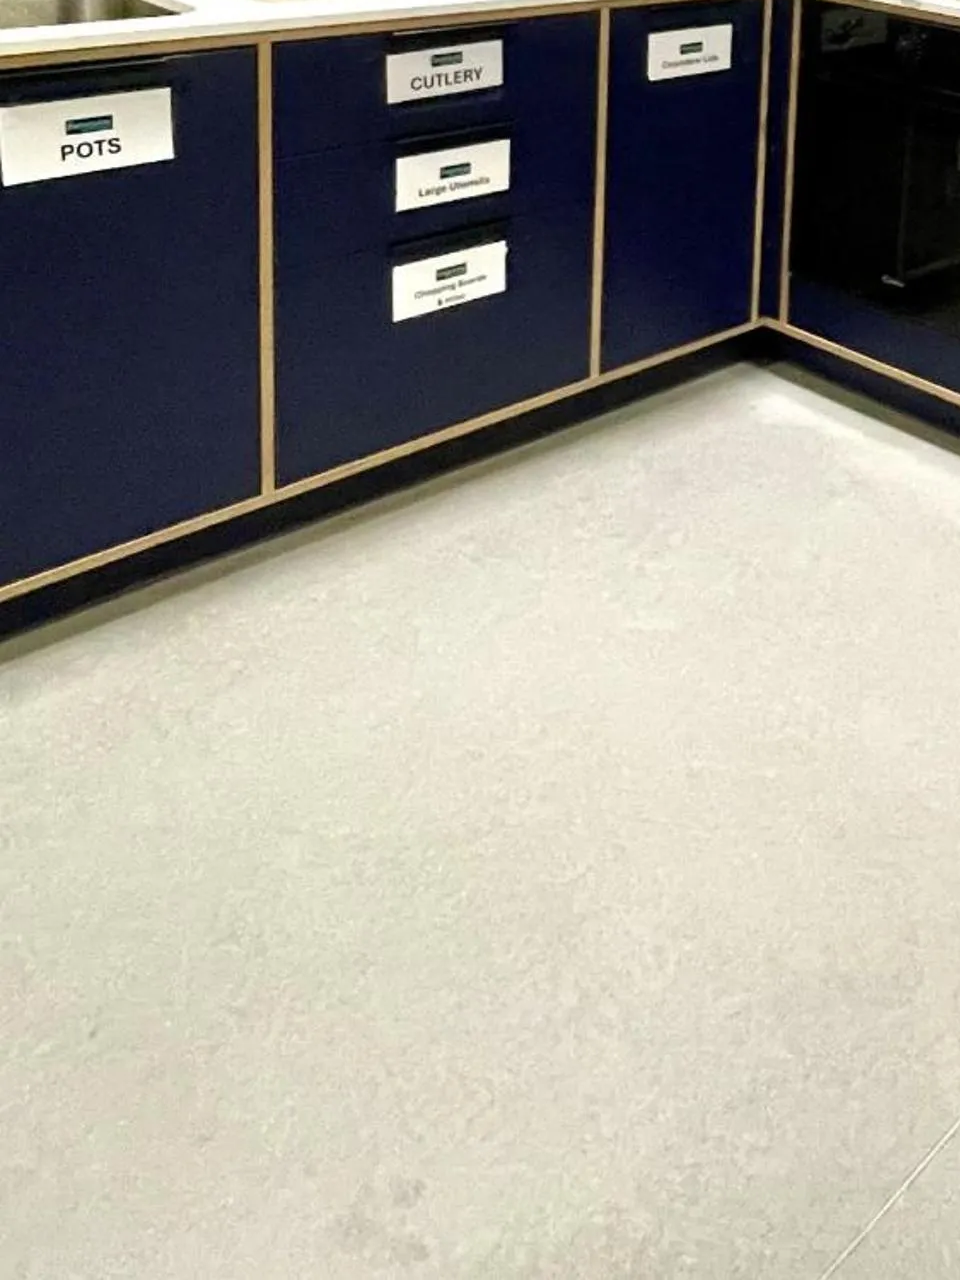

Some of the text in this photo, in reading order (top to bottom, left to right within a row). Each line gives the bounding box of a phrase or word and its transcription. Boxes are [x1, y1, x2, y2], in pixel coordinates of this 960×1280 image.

[410, 67, 484, 91] CUTLERY
[60, 137, 122, 162] POTS
[418, 185, 447, 197] Large
